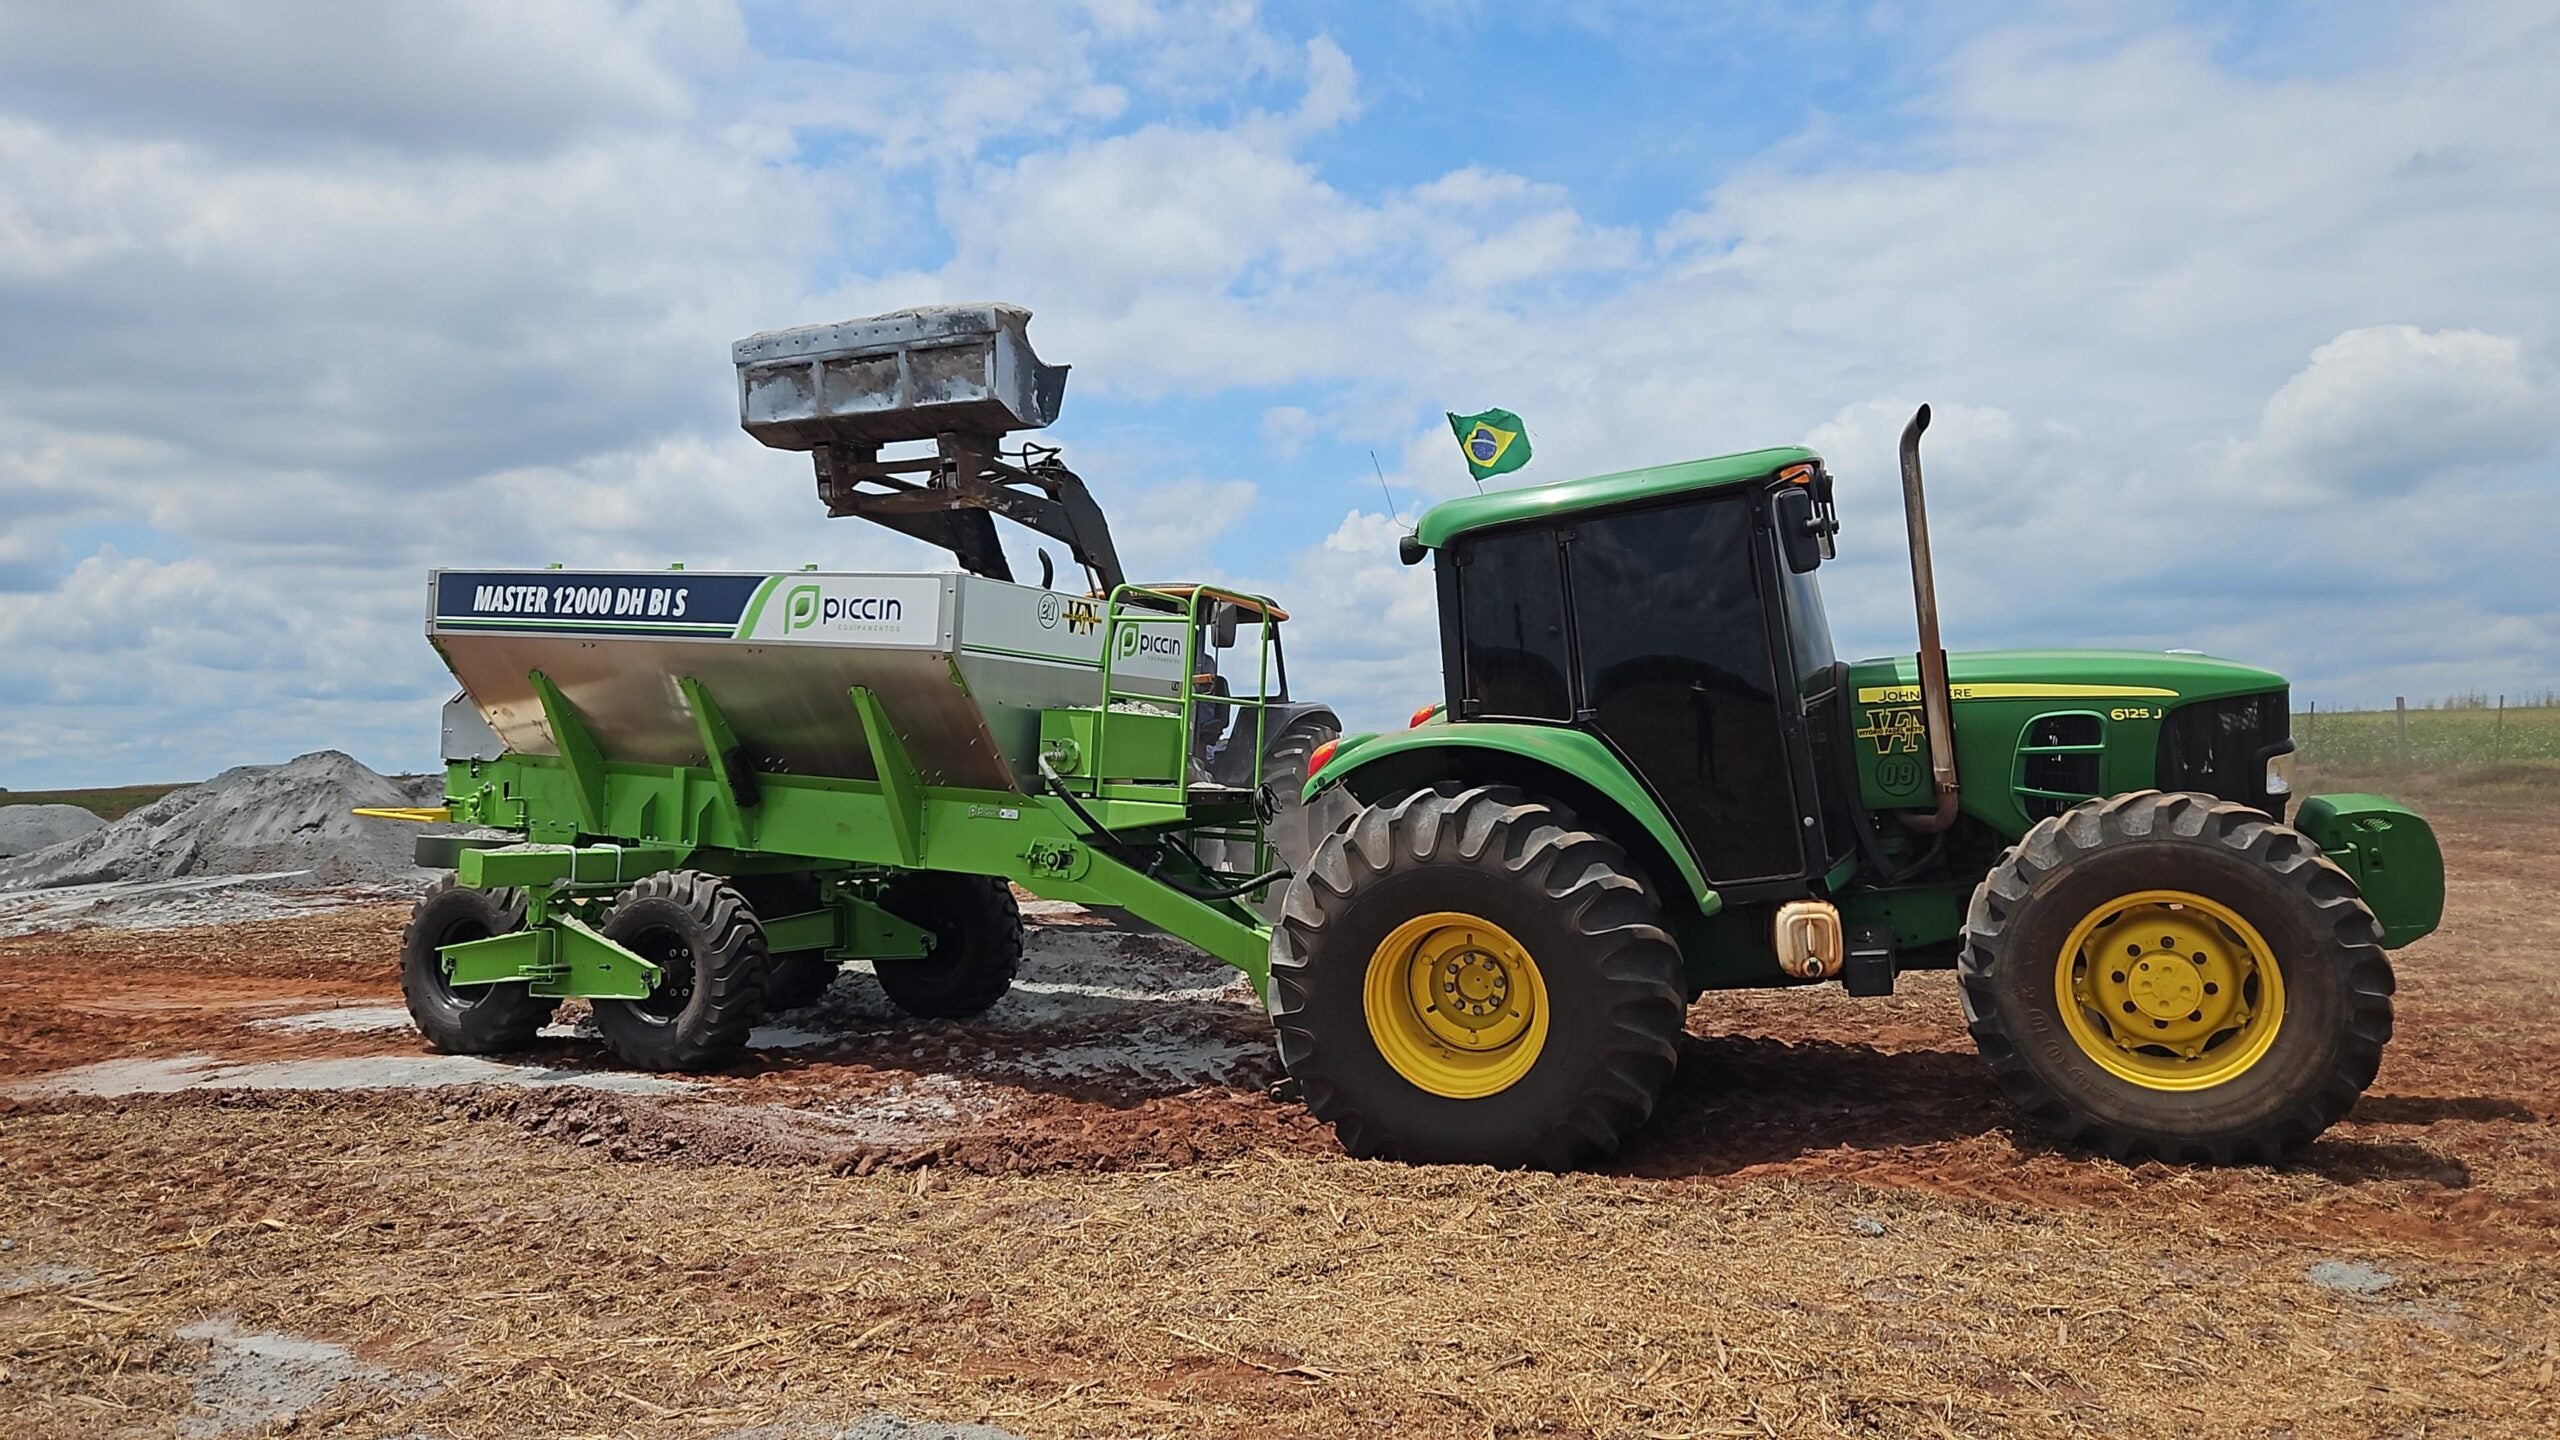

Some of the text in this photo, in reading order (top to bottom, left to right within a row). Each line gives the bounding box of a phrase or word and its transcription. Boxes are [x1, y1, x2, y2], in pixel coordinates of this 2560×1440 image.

[473, 585, 689, 617] MASTER 12000 DH BI S
[1040, 600, 1056, 621] 21
[1878, 690, 1920, 701] JOHN
[2110, 708, 2162, 721] 6125 J
[1881, 761, 1915, 787] 09
